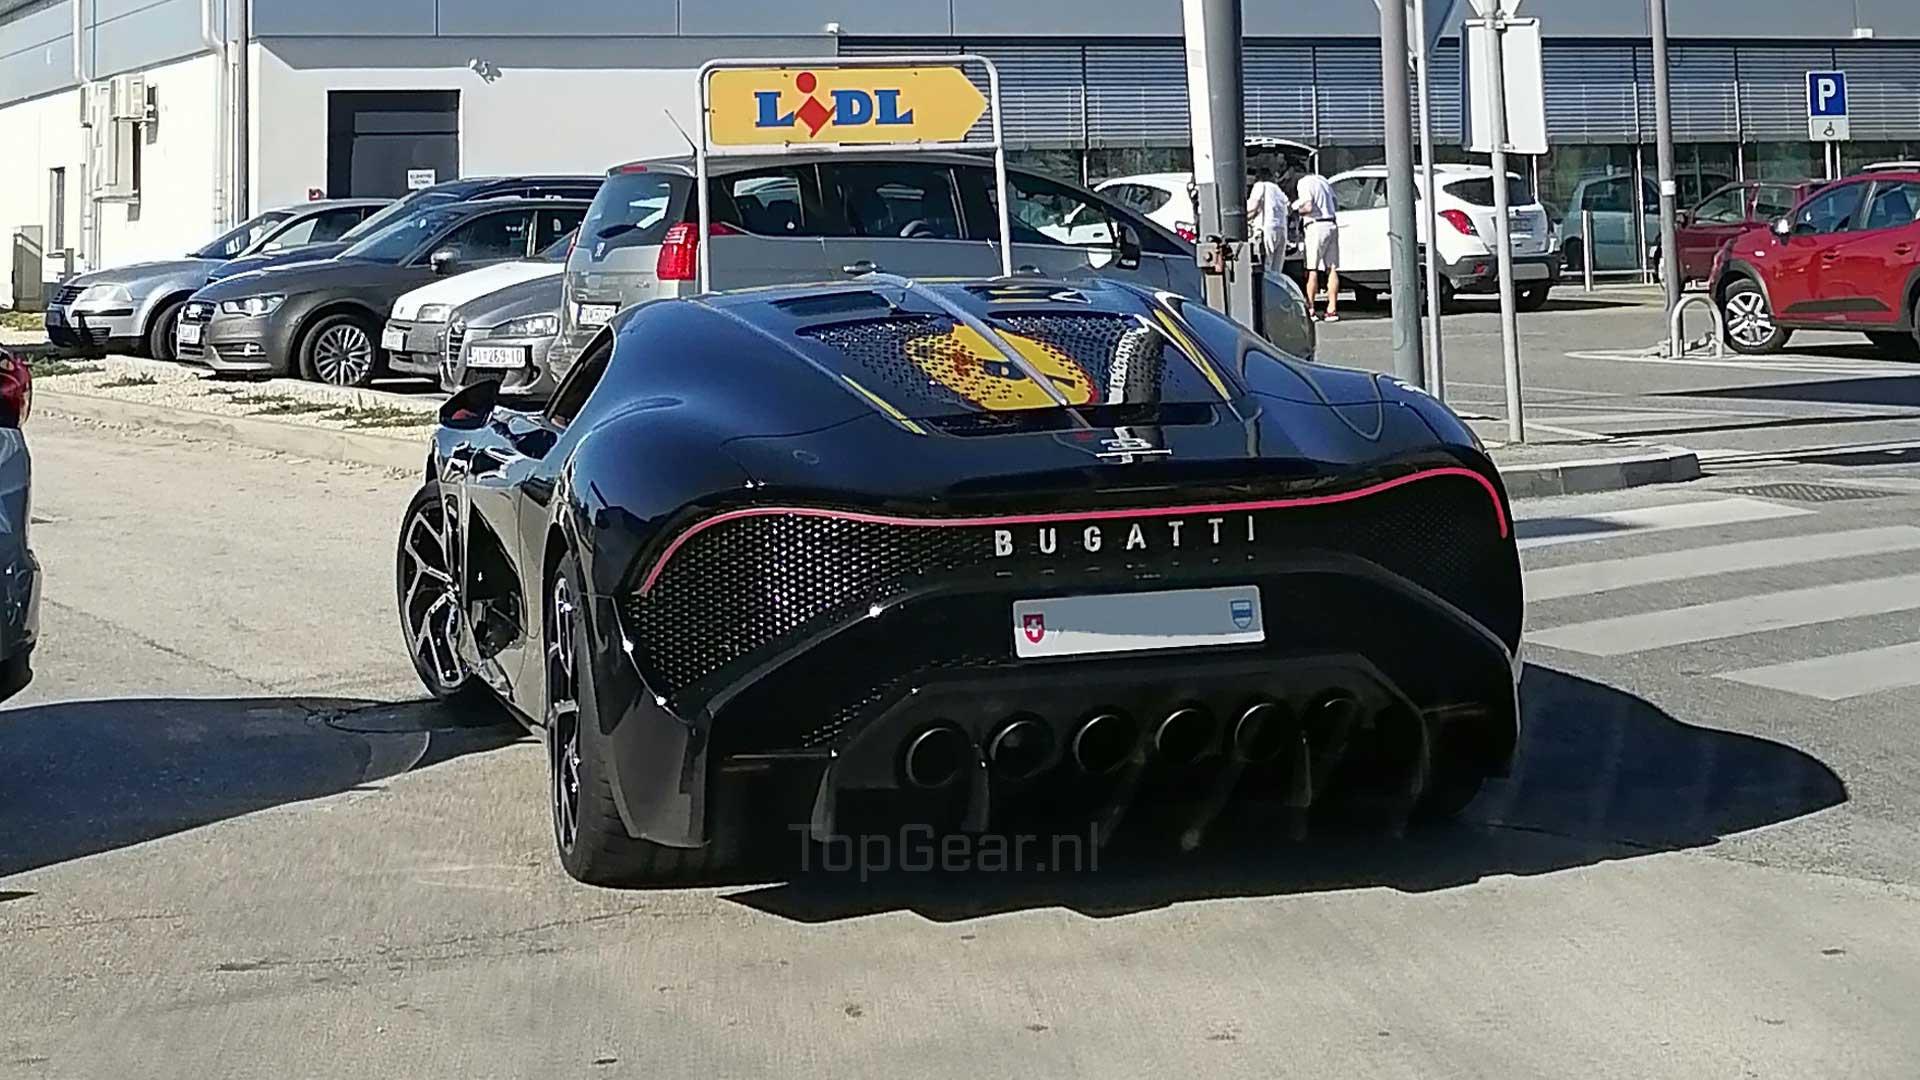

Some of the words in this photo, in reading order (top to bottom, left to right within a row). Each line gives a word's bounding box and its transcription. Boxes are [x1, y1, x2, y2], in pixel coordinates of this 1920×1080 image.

[754, 72, 913, 138] LIDL
[1818, 79, 1836, 111] P
[995, 515, 1255, 556] BUGATTI
